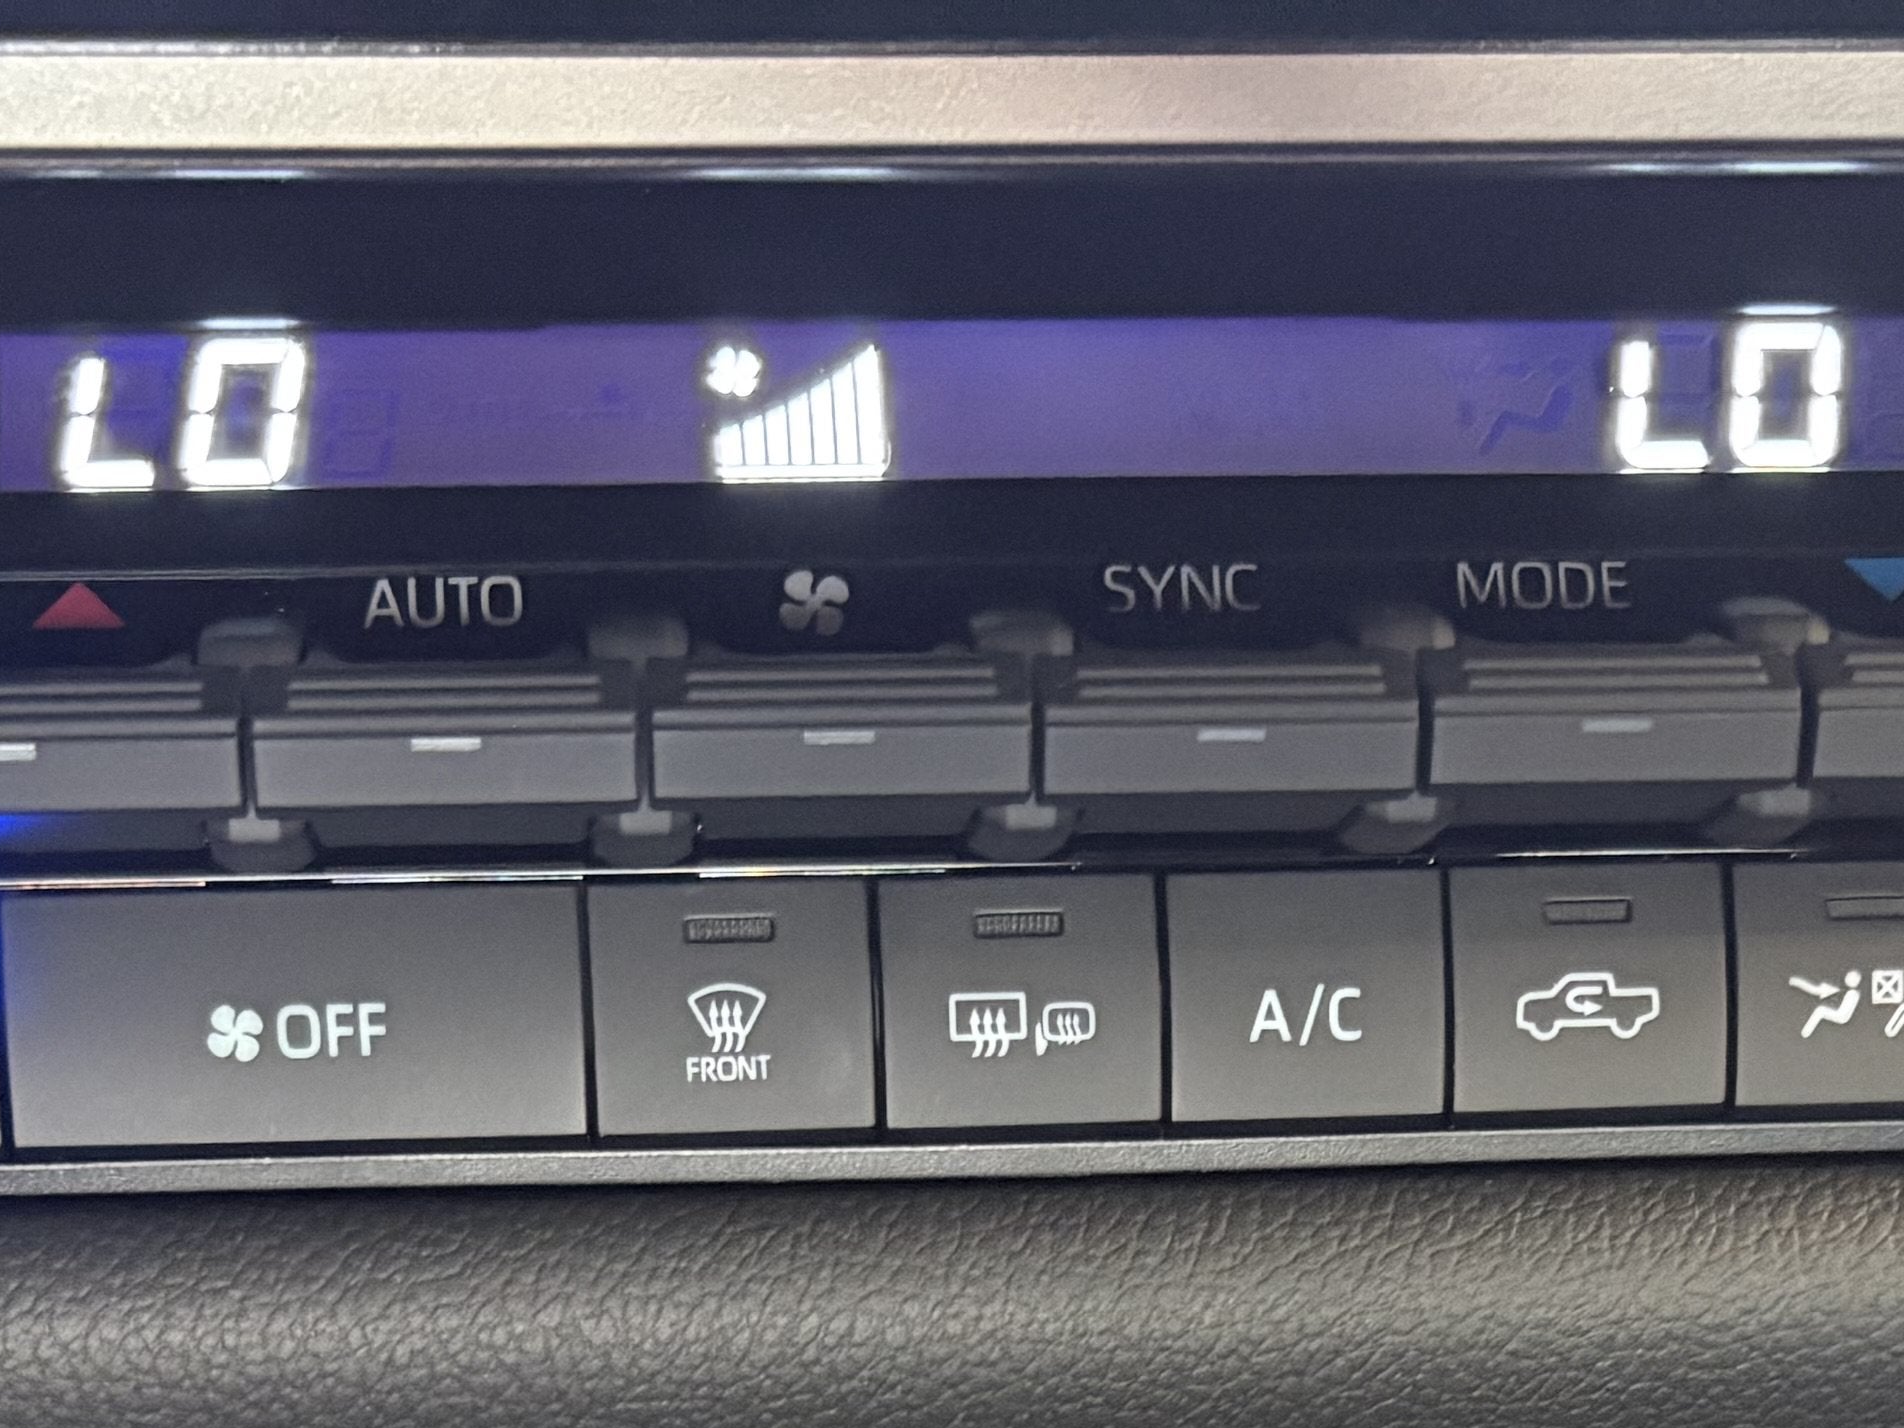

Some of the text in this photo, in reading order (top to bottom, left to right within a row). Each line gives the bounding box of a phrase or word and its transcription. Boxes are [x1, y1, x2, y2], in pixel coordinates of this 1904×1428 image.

[362, 575, 523, 628] AUTO
[1102, 563, 1259, 613] SYNC
[1456, 559, 1629, 609] MODE
[276, 1002, 387, 1058] OFF
[1249, 984, 1363, 1047] A/C
[686, 1055, 771, 1083] FRONT
